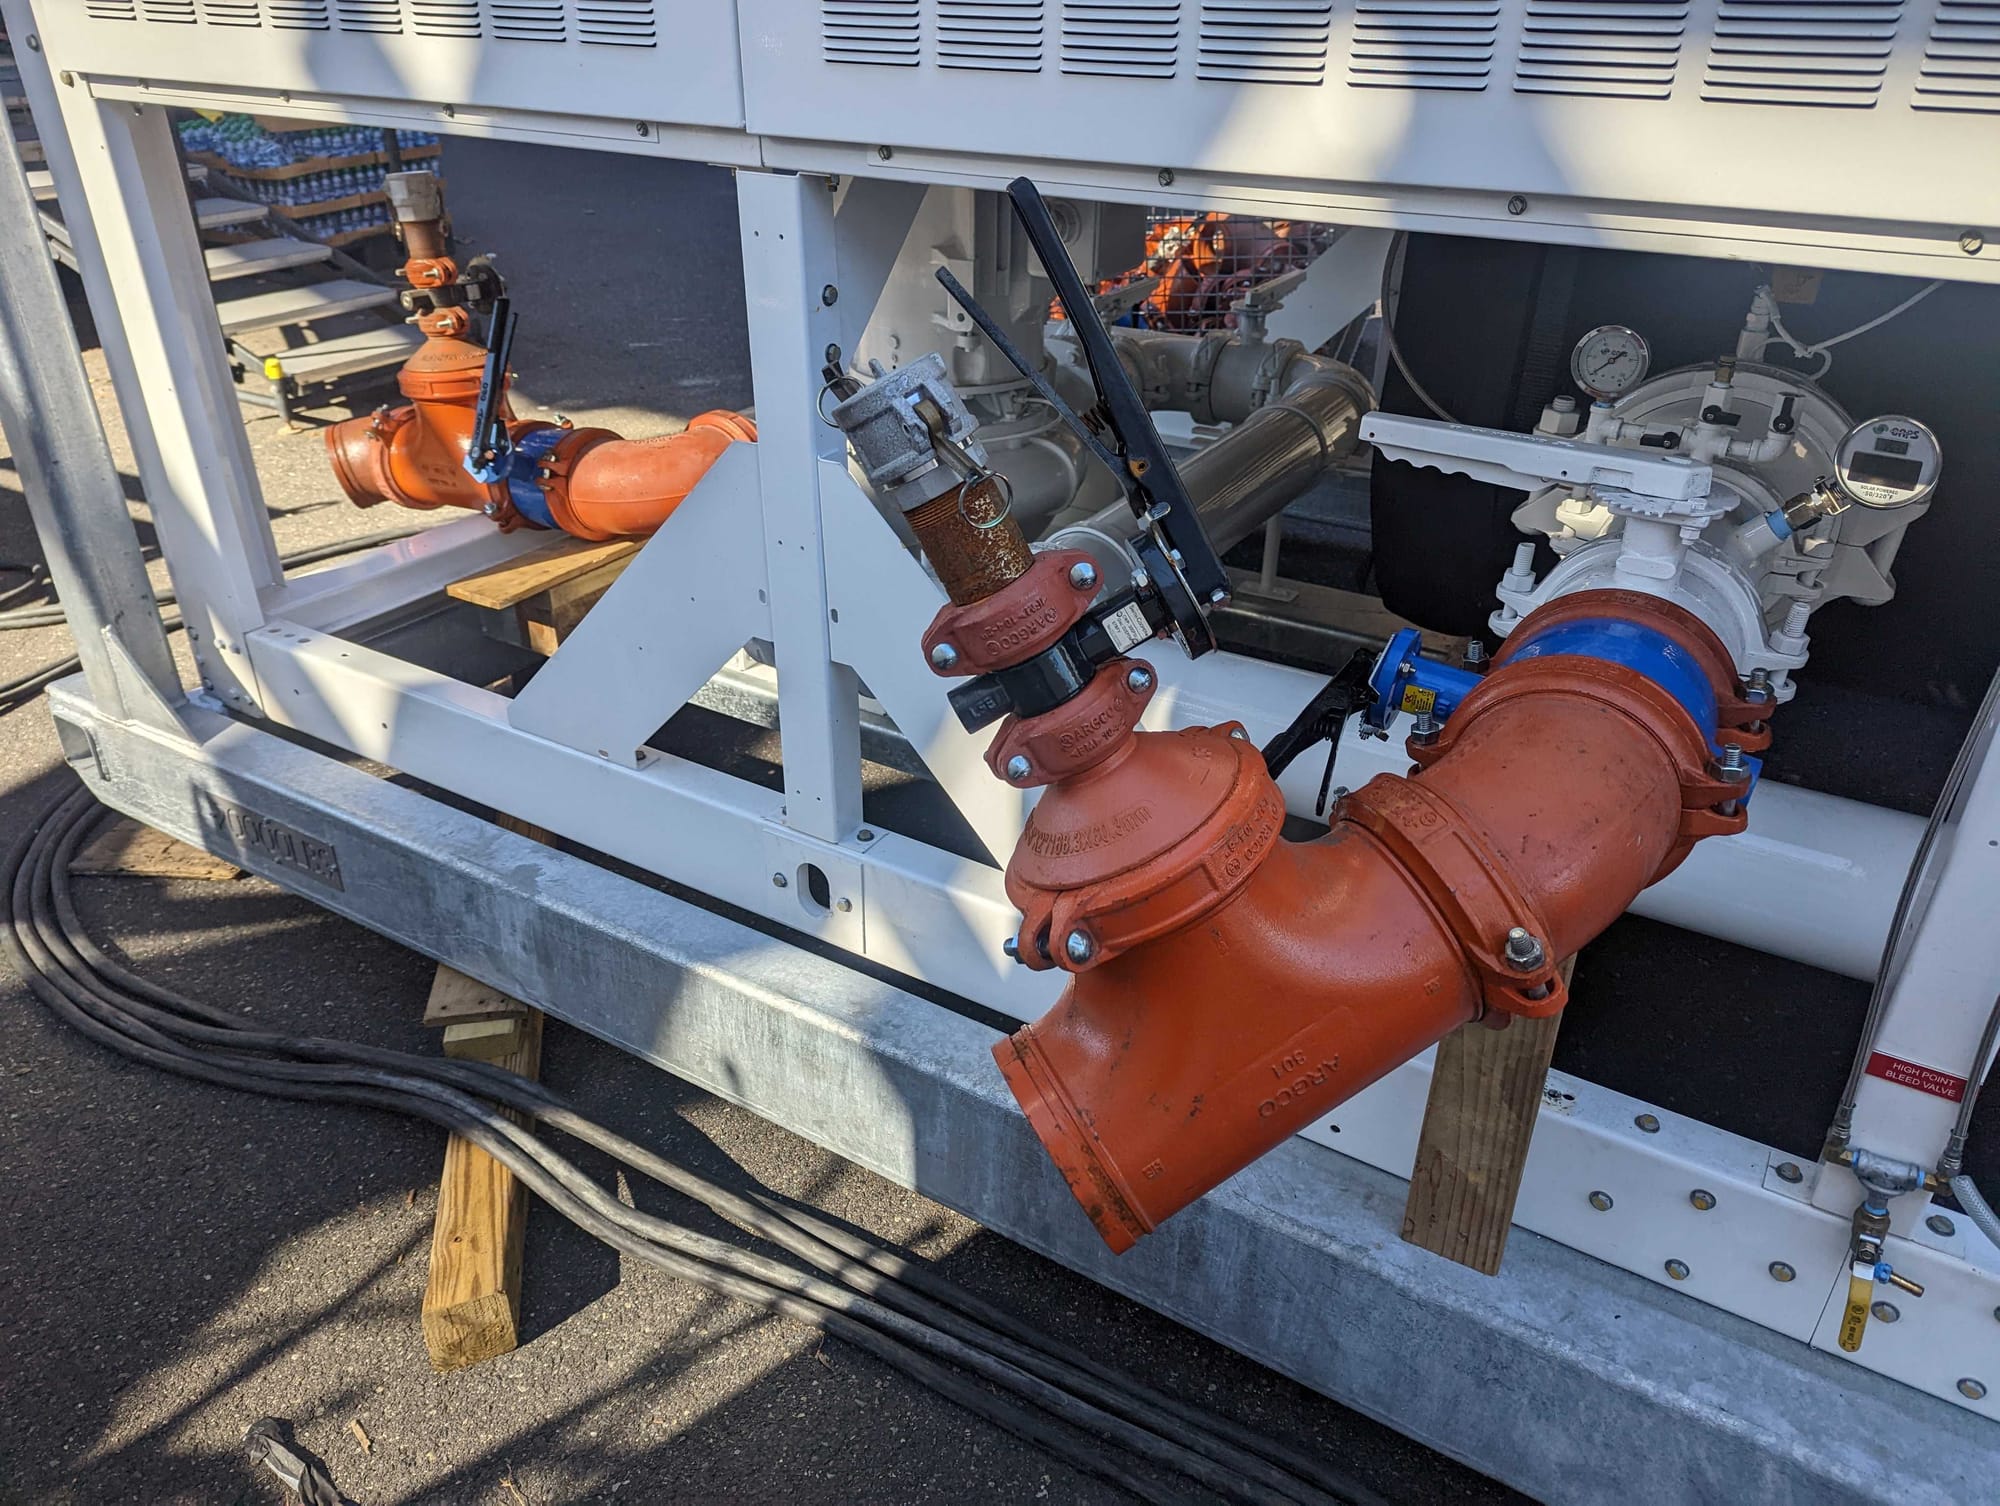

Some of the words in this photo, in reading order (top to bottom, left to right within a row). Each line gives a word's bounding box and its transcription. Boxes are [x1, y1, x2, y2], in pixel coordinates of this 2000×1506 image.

[1860, 484, 1876, 492] SOLAR
[1875, 486, 1899, 495] POWERED
[1271, 1049, 1307, 1079] 301
[1892, 1062, 1920, 1077] HIGH
[1921, 1071, 1957, 1087] POINT
[1258, 1052, 1339, 1118] ARGCO
[1885, 1069, 1920, 1086] BLEED
[1922, 1081, 1957, 1097] VALVE
